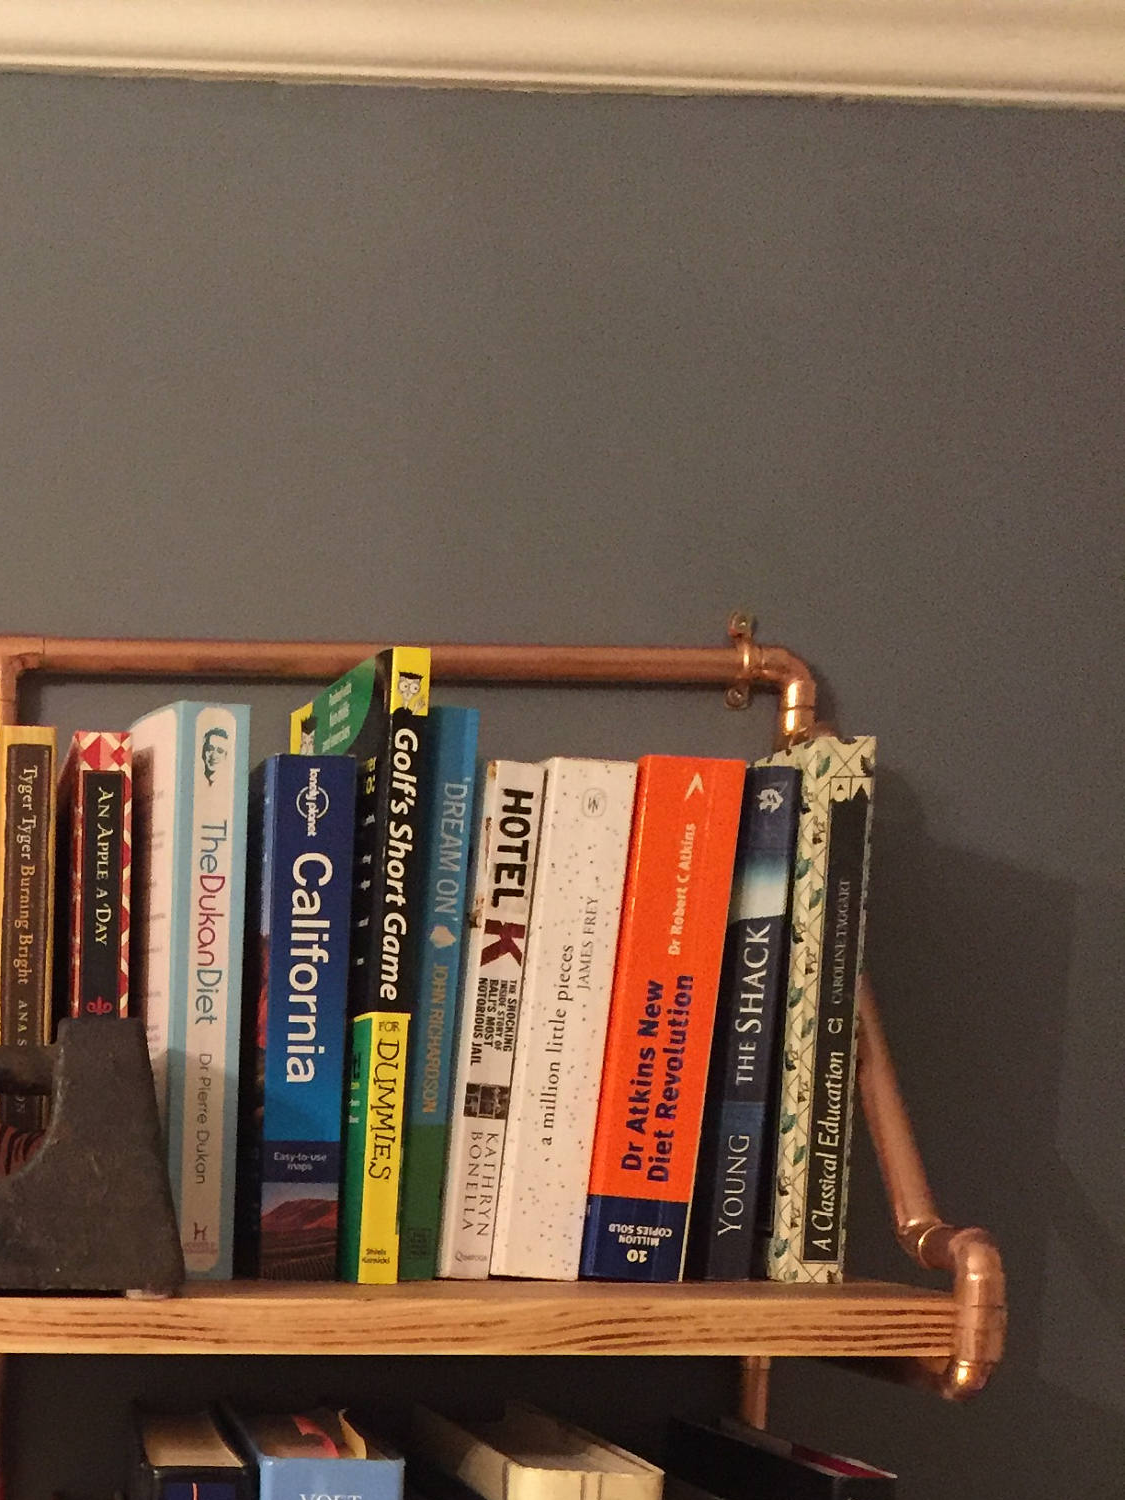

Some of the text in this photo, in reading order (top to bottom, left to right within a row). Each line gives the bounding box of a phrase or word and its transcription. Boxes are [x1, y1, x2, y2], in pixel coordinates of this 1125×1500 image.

[18, 765, 38, 811] Tyger
[97, 786, 114, 818] AN
[306, 801, 319, 836] planet
[16, 816, 36, 860] Tyger
[96, 823, 114, 880] APPLE
[380, 728, 419, 1001] Golf's Short Game
[14, 865, 35, 929] Burning
[480, 788, 534, 967] HOTEL K
[13, 935, 33, 985] Bright
[95, 903, 113, 946] DAY
[577, 896, 599, 991] JAMES FREY
[286, 852, 334, 1083] California
[735, 923, 771, 1086] THE SHACK
[470, 977, 488, 1066] NOTORIOUS JAIL
[484, 1016, 495, 1047] MOST
[503, 998, 517, 1052] SHOCKING
[197, 1076, 211, 1125] Pierre
[368, 1039, 400, 1183] DUMMIES
[621, 980, 664, 1170] Dr Atkins New
[647, 974, 694, 1182] Diet Revolution
[816, 1051, 844, 1147] Education
[195, 1130, 211, 1184] Dukan
[274, 1152, 327, 1162] Easy-to-use
[462, 1131, 484, 1231] BONELLA
[476, 1132, 499, 1237] KATHRYN
[718, 1134, 751, 1236] YOUNG
[812, 1156, 837, 1232] Classical
